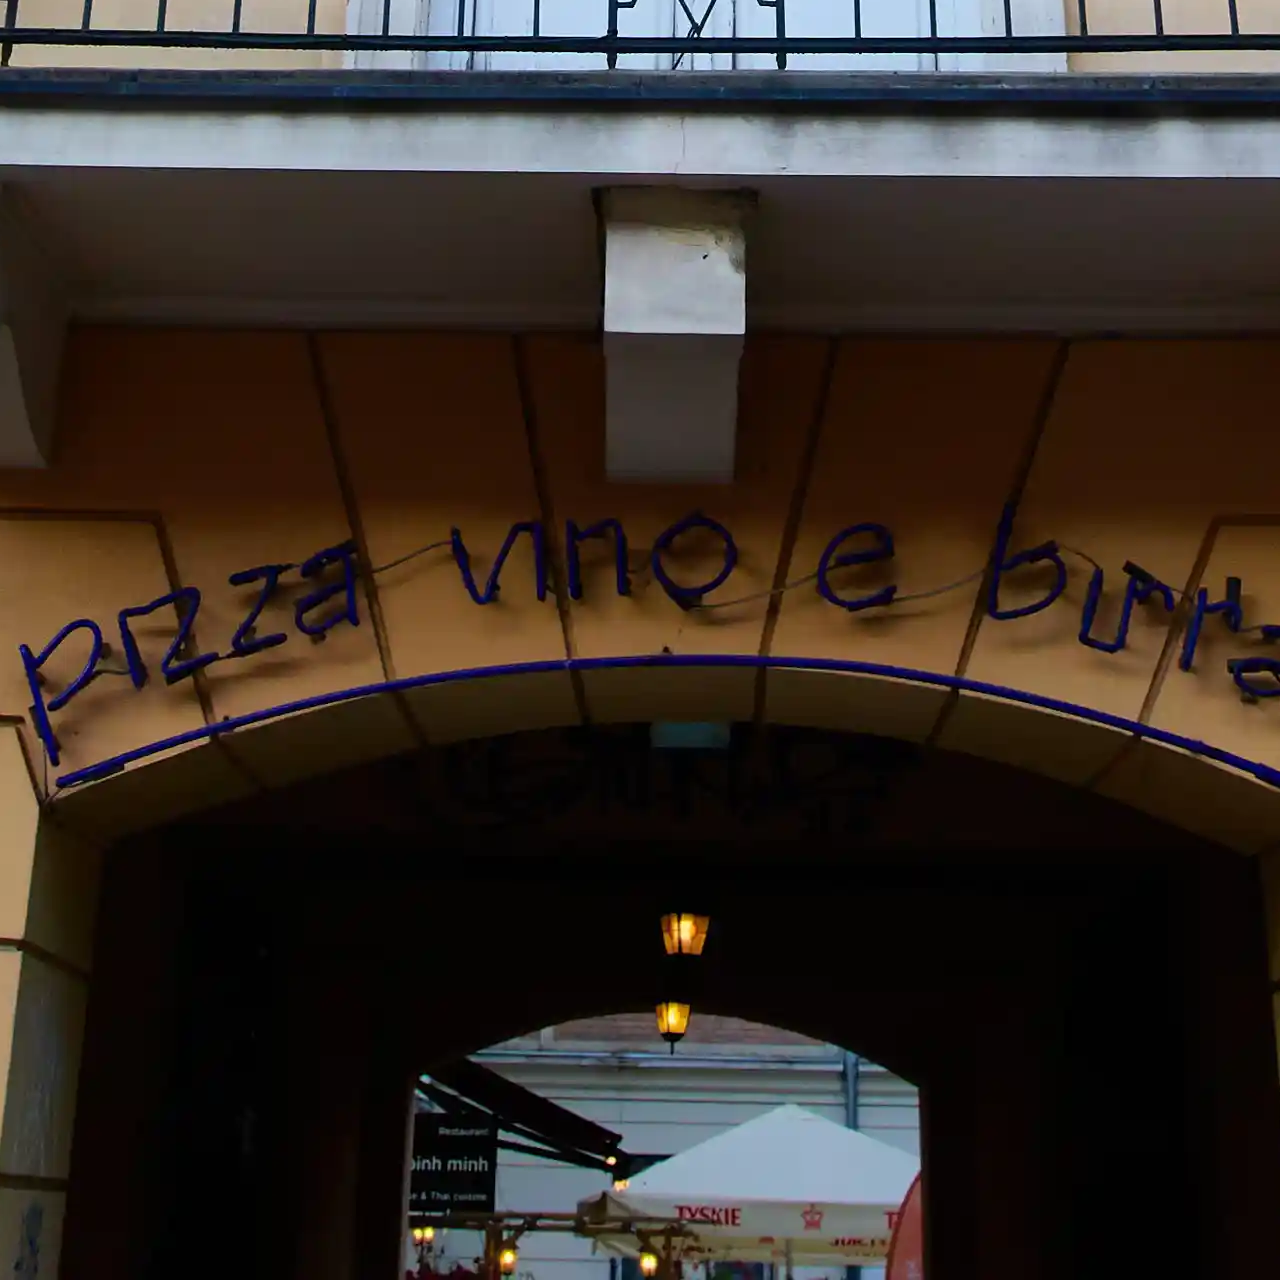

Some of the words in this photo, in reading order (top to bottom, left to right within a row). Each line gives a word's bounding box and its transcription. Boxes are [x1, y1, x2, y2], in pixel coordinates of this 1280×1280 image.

[19, 539, 360, 767] pizza
[450, 509, 739, 612] vino
[816, 522, 898, 612] e
[446, 1154, 490, 1172] minh
[674, 1205, 742, 1227] TYSKIE
